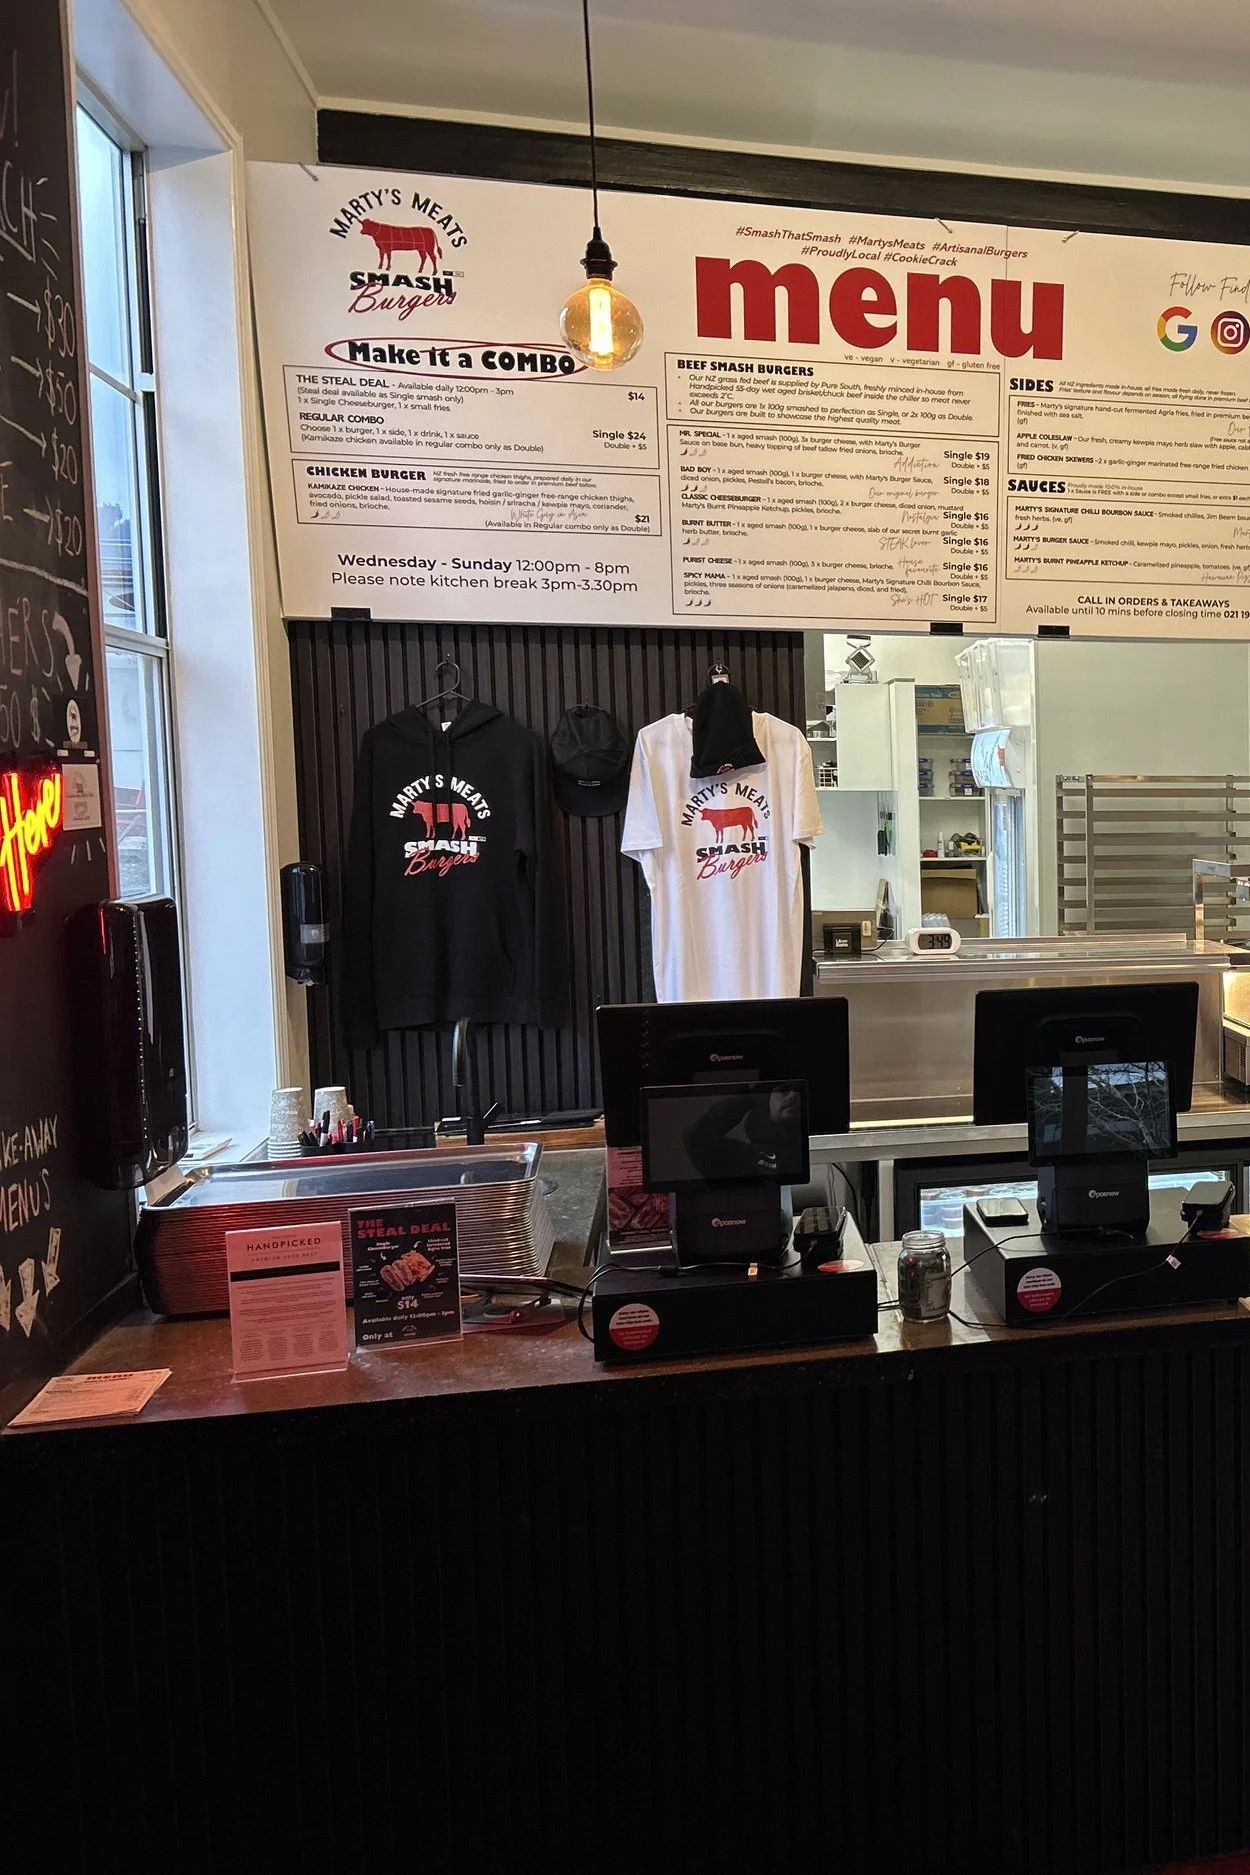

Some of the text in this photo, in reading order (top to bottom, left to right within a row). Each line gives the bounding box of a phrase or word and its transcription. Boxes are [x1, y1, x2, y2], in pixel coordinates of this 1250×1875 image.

[329, 189, 468, 250] MARTY'S MEATS
[735, 226, 1028, 260] #SmashThatSmash #MartysMeats #ArtisanalBurgers
[801, 245, 958, 268] #ProudlyLocal #CookieCrack
[349, 270, 454, 295] SMASH
[1170, 273, 1216, 298] Follow
[348, 283, 458, 321] Burgers
[695, 255, 1065, 361] menu
[348, 341, 575, 374] Make it a COMBO
[677, 359, 815, 377] BEEF SMASH BURGERS
[296, 375, 319, 384] THE
[321, 377, 356, 387] STEAL
[360, 379, 390, 389] DEAL
[397, 382, 435, 392] Available
[437, 384, 455, 394] daily
[1009, 378, 1054, 392] SIDES
[628, 391, 645, 401] $14
[299, 412, 385, 425] REGULAR COMBO
[592, 430, 647, 441] Single $24
[943, 450, 990, 462] Single $19
[306, 466, 427, 482] CHICKEN BURGER
[943, 476, 990, 487] Single $18
[1007, 479, 1066, 494] SAUCES
[634, 514, 650, 524] $21
[943, 511, 989, 521] Single $16
[942, 537, 989, 547] Single $16
[338, 554, 630, 576] Wednesday Sunday 12:00pm 8pm
[942, 562, 989, 572] Single $16
[332, 572, 638, 594] Please note kitchen break 3pm-3.30pm
[942, 594, 988, 605] Single $17
[1078, 596, 1103, 605] CALL
[1105, 597, 1115, 605] IN
[1118, 597, 1159, 607] ORDERS
[1170, 599, 1230, 609] TAKEAWAYS
[1026, 605, 1070, 615] Available
[1072, 607, 1094, 616] until
[1096, 608, 1106, 616] 10
[1108, 608, 1131, 617] mins
[1133, 608, 1164, 618] before
[1166, 609, 1198, 620] closing
[1201, 610, 1222, 619] time
[1224, 610, 1238, 619] 021
[450, 777, 491, 820] MEATS
[681, 782, 771, 827] MARTY'S MEATS
[403, 839, 478, 858] SMASH
[696, 842, 766, 863] SMASH
[403, 849, 480, 877] Burgers
[696, 852, 768, 880] Burgers
[247, 1237, 321, 1251] HANDPICKED
